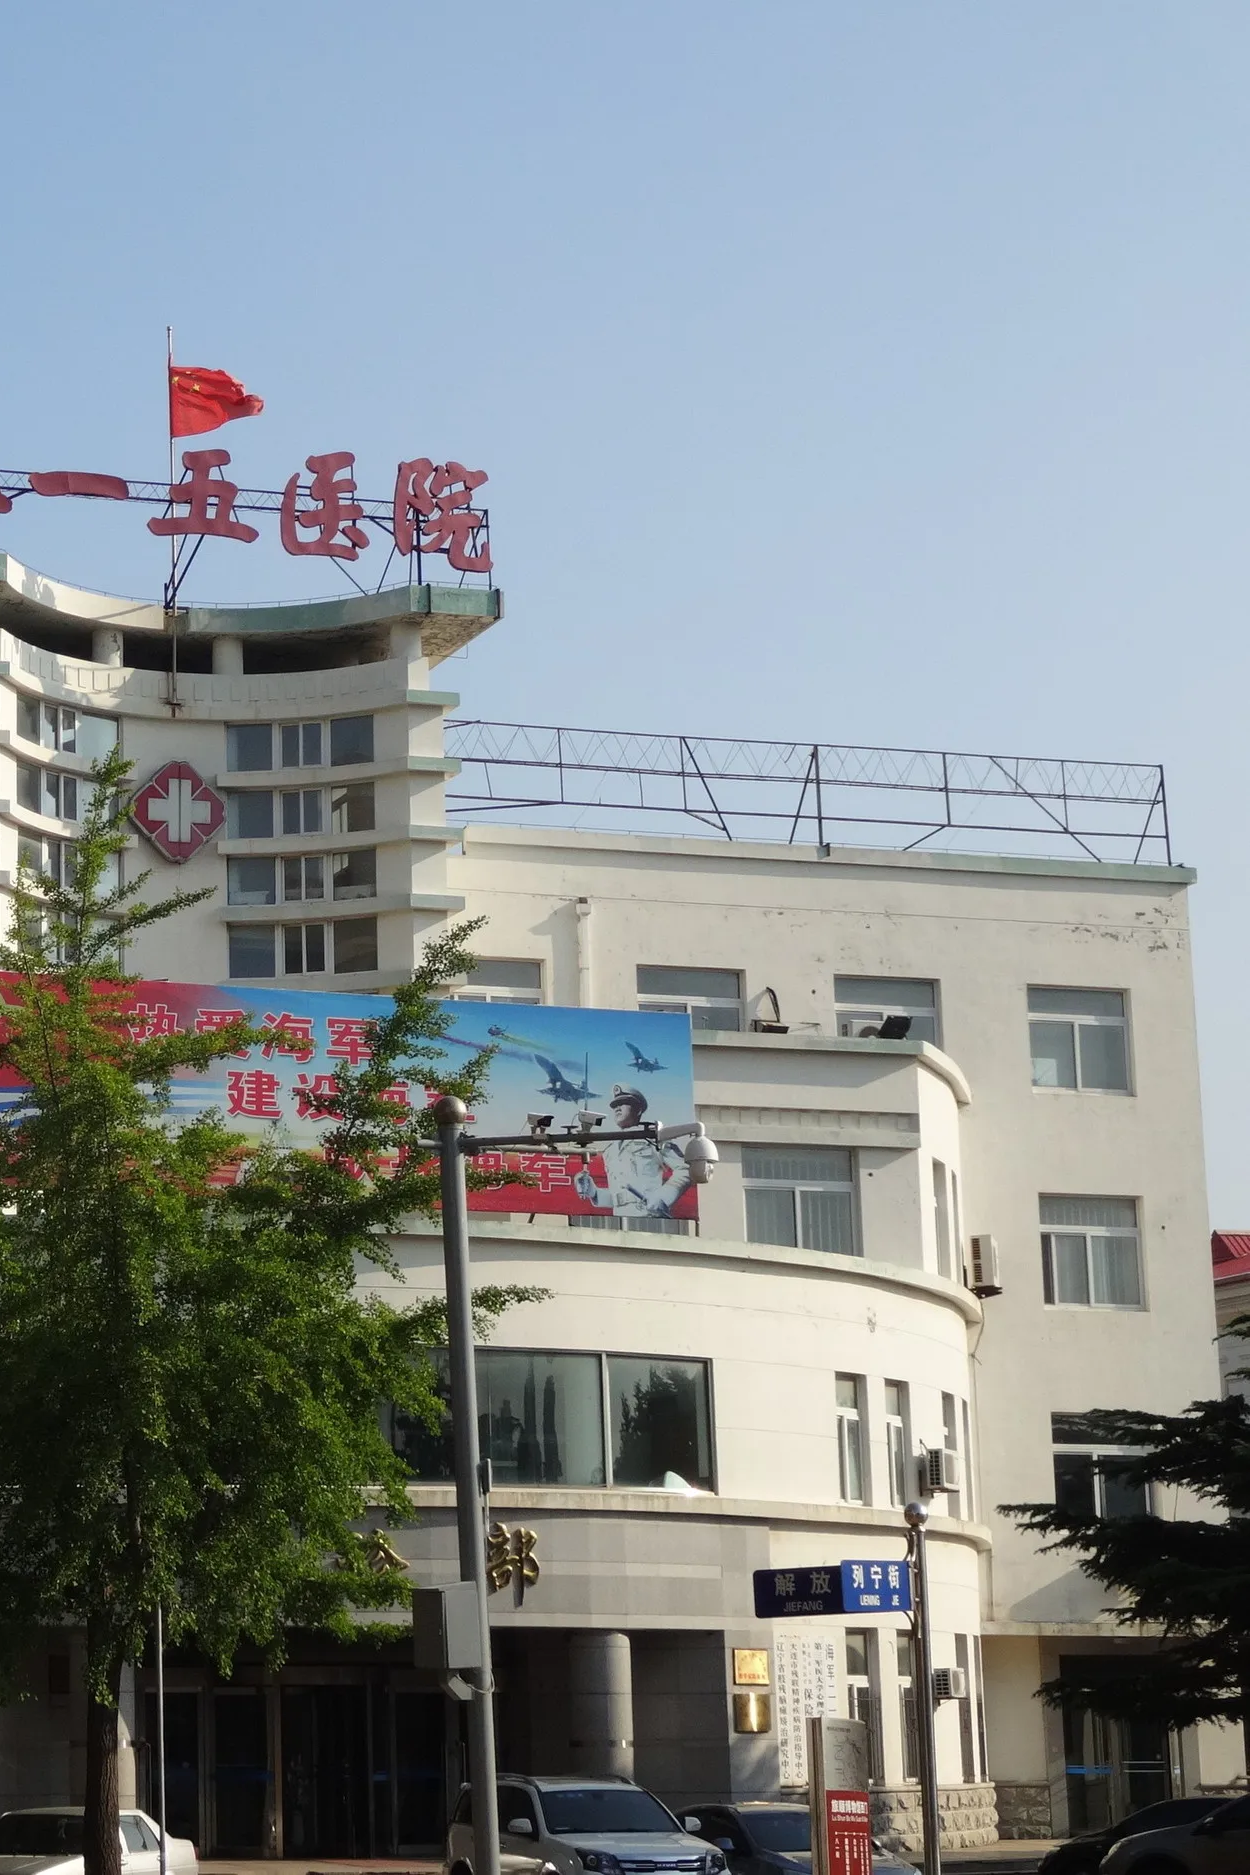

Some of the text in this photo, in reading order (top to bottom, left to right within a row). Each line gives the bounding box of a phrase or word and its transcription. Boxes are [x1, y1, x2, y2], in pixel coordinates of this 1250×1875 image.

[774, 1571, 832, 1597] 解放
[851, 1564, 900, 1590] 列宁街
[783, 1600, 824, 1613] JIEFANG
